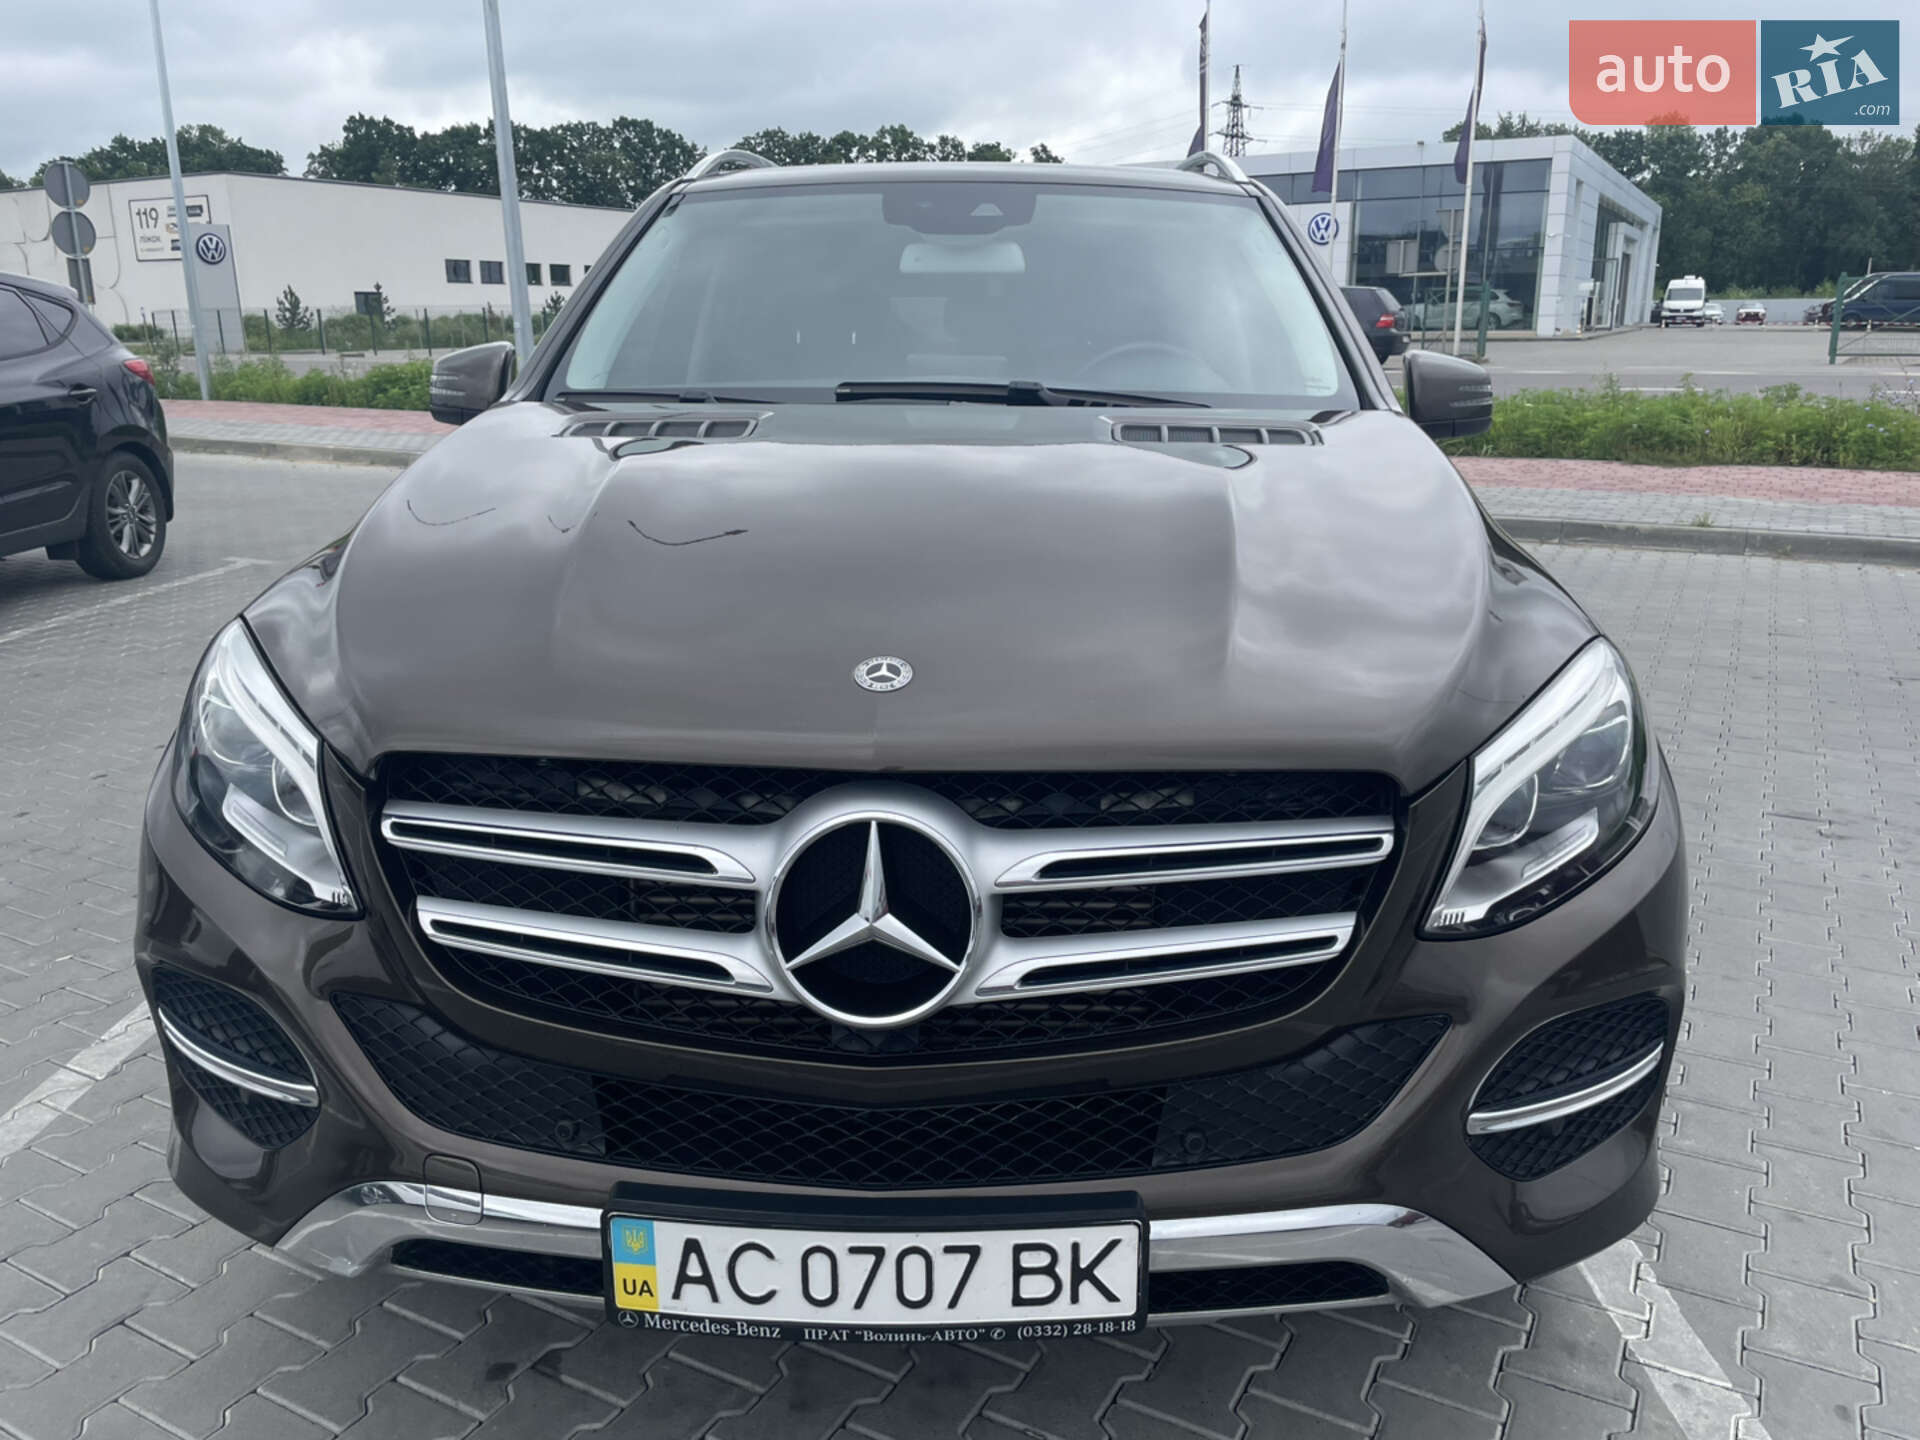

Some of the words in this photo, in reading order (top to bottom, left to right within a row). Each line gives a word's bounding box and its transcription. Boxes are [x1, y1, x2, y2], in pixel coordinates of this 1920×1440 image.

[135, 207, 159, 229] 119
[671, 1237, 778, 1304] AC
[800, 1244, 981, 1310] 0707
[1010, 1238, 1123, 1307] BK
[622, 1276, 655, 1298] UA
[644, 1312, 781, 1339] Mercedes-Benz
[803, 1328, 850, 1342] ПРАТ
[1017, 1325, 1068, 1341] (0332)
[1073, 1319, 1137, 1336] 28-18-18
